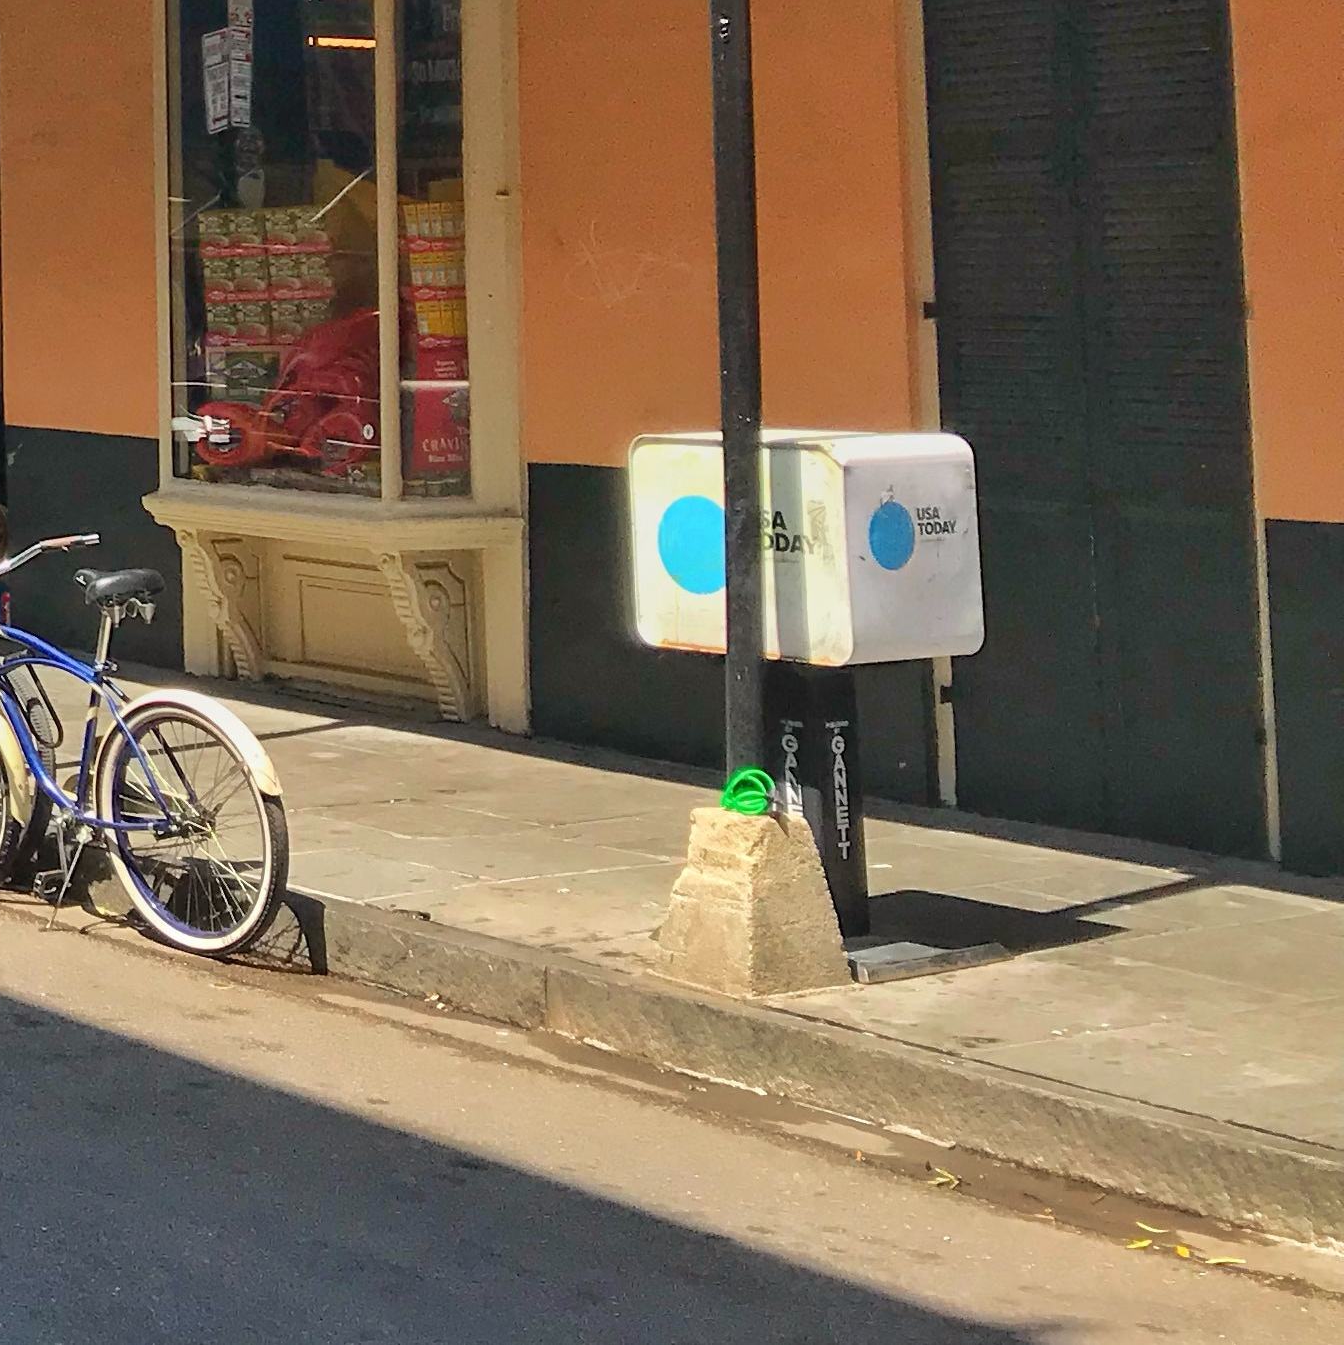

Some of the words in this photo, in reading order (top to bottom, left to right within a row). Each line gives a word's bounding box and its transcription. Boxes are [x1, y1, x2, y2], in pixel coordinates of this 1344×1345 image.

[760, 510, 787, 531] SA
[916, 507, 941, 521] USA
[918, 520, 958, 536] TODAY
[760, 533, 816, 555] ODAY
[831, 734, 852, 860] GANNETT
